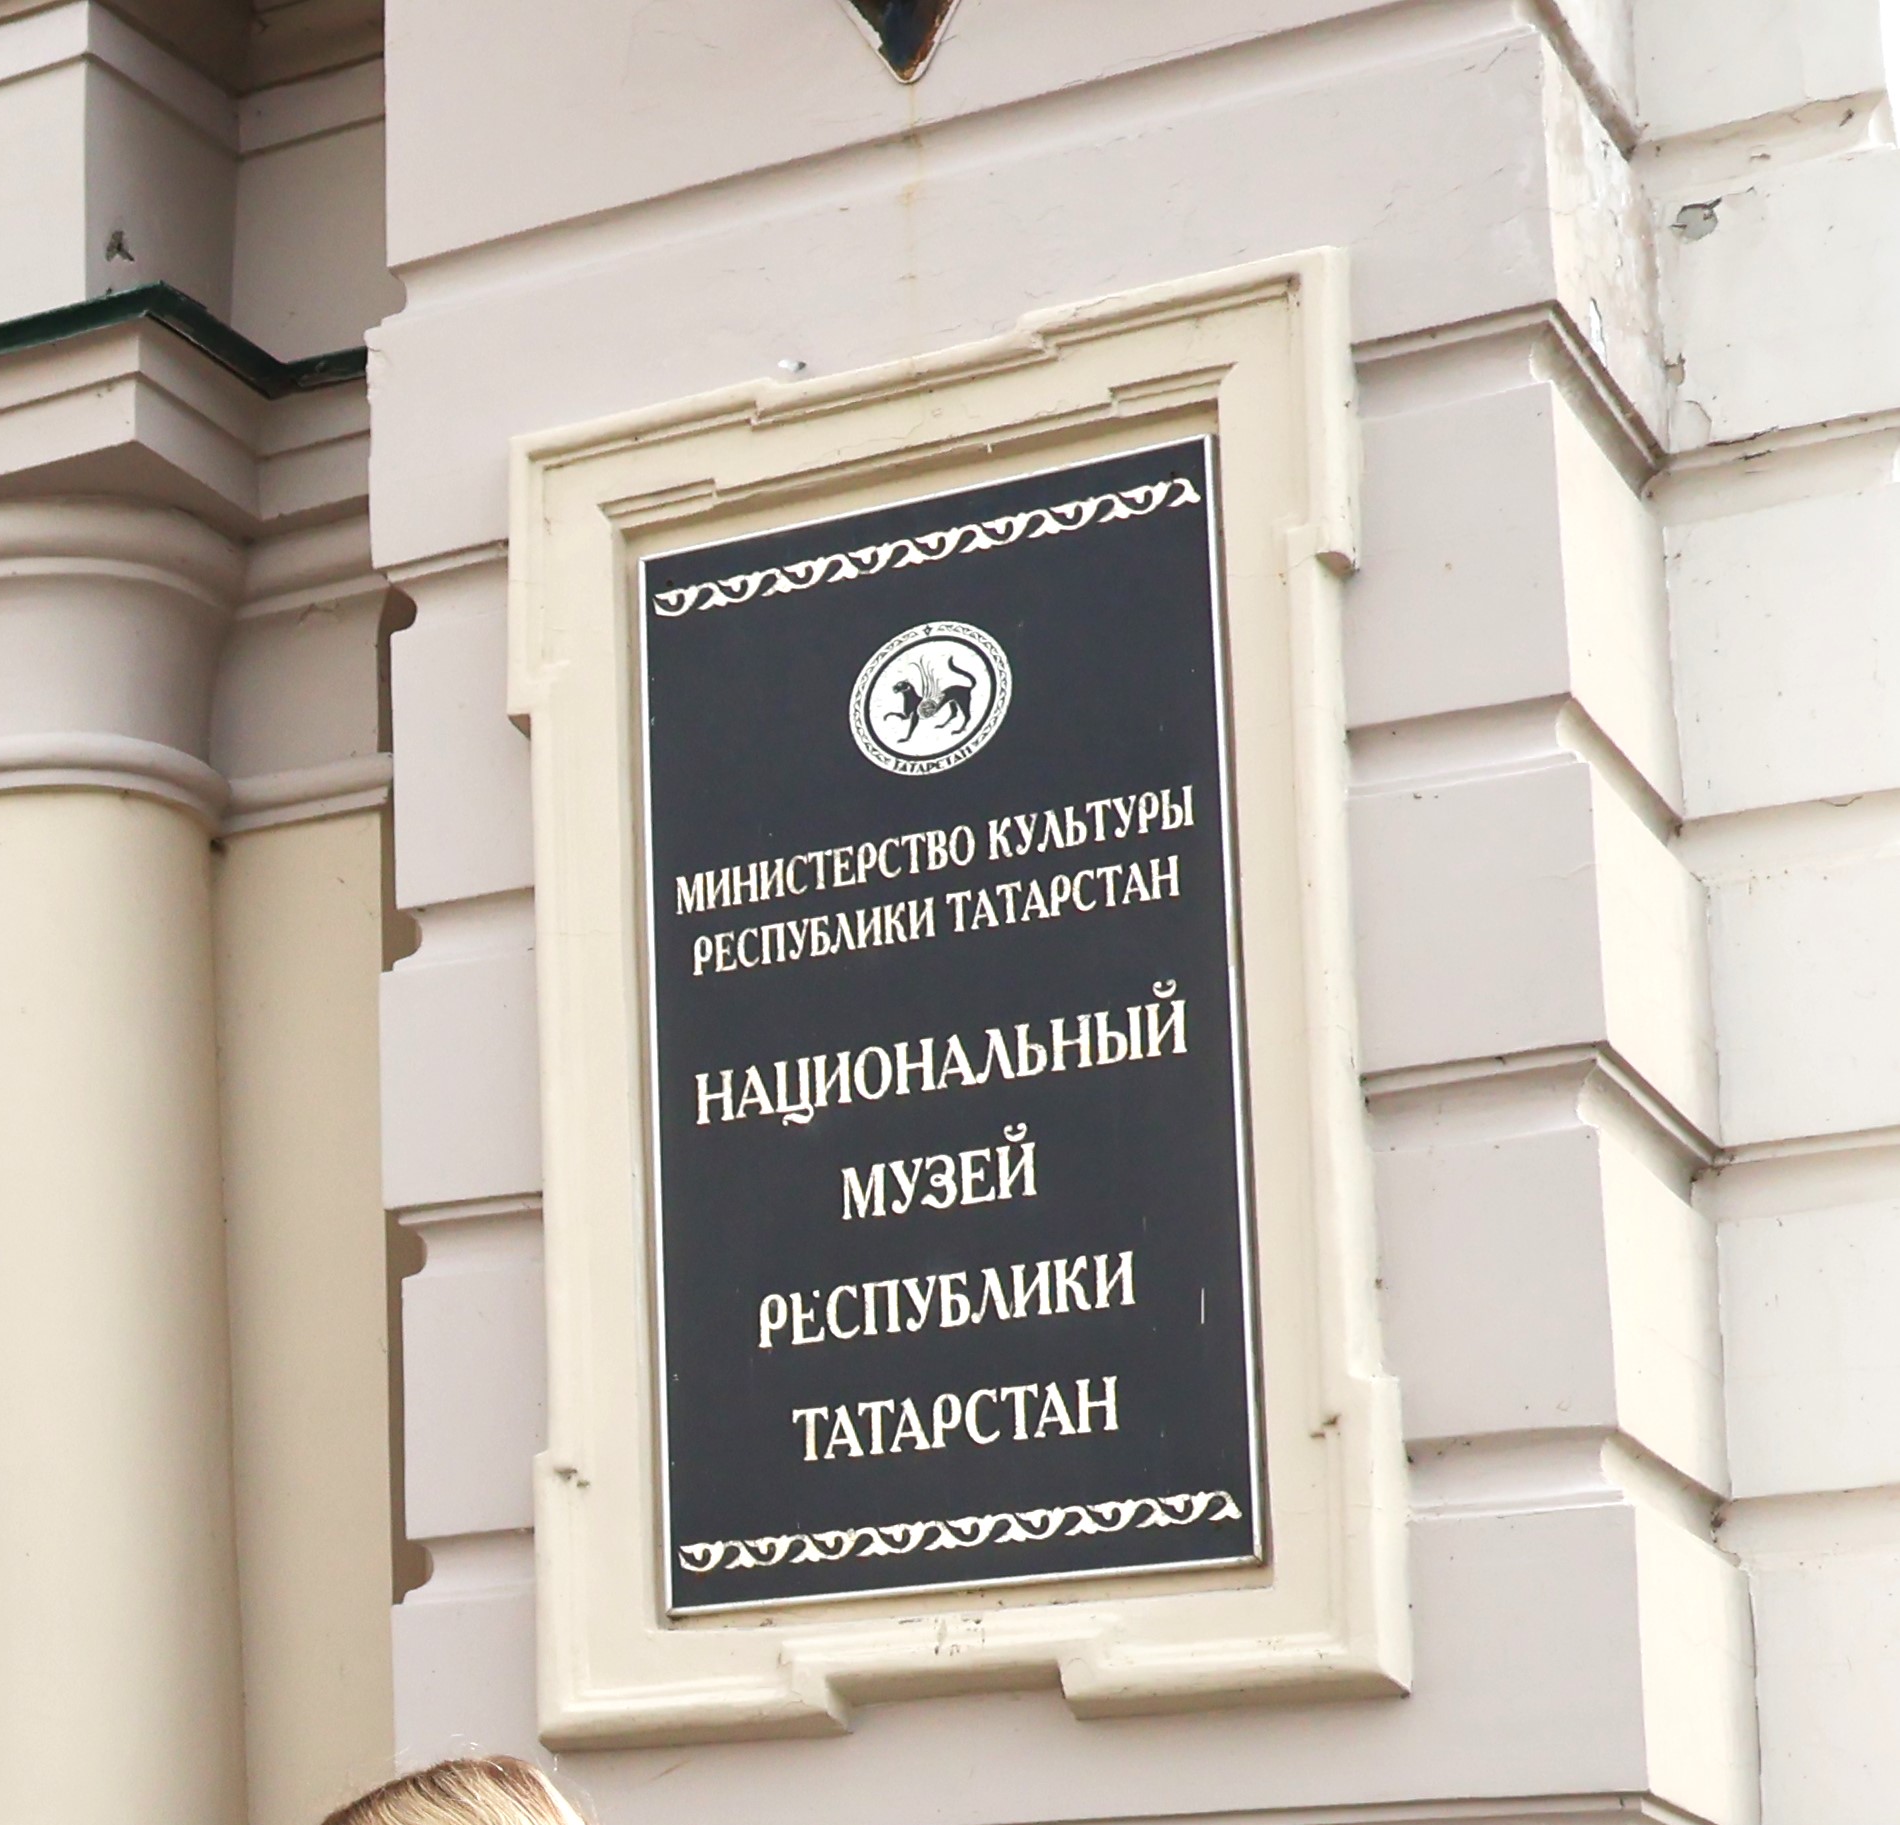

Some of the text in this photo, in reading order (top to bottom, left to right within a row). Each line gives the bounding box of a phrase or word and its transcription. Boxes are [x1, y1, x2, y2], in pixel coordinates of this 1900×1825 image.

[675, 784, 1195, 915] МИНИСТЕРСТВО КУЛЬТУРЫ
[692, 854, 1180, 976] РЕСПУБЛИКИ ТАТАРСТАН
[695, 978, 1189, 1128] НАЦИОНАЛЬНЫЙ
[841, 1122, 1039, 1222] МУЗЕЙ
[757, 1250, 1137, 1350] РЕСПУБЛИКИ
[792, 1375, 1120, 1462] ТАТАРСТАН
